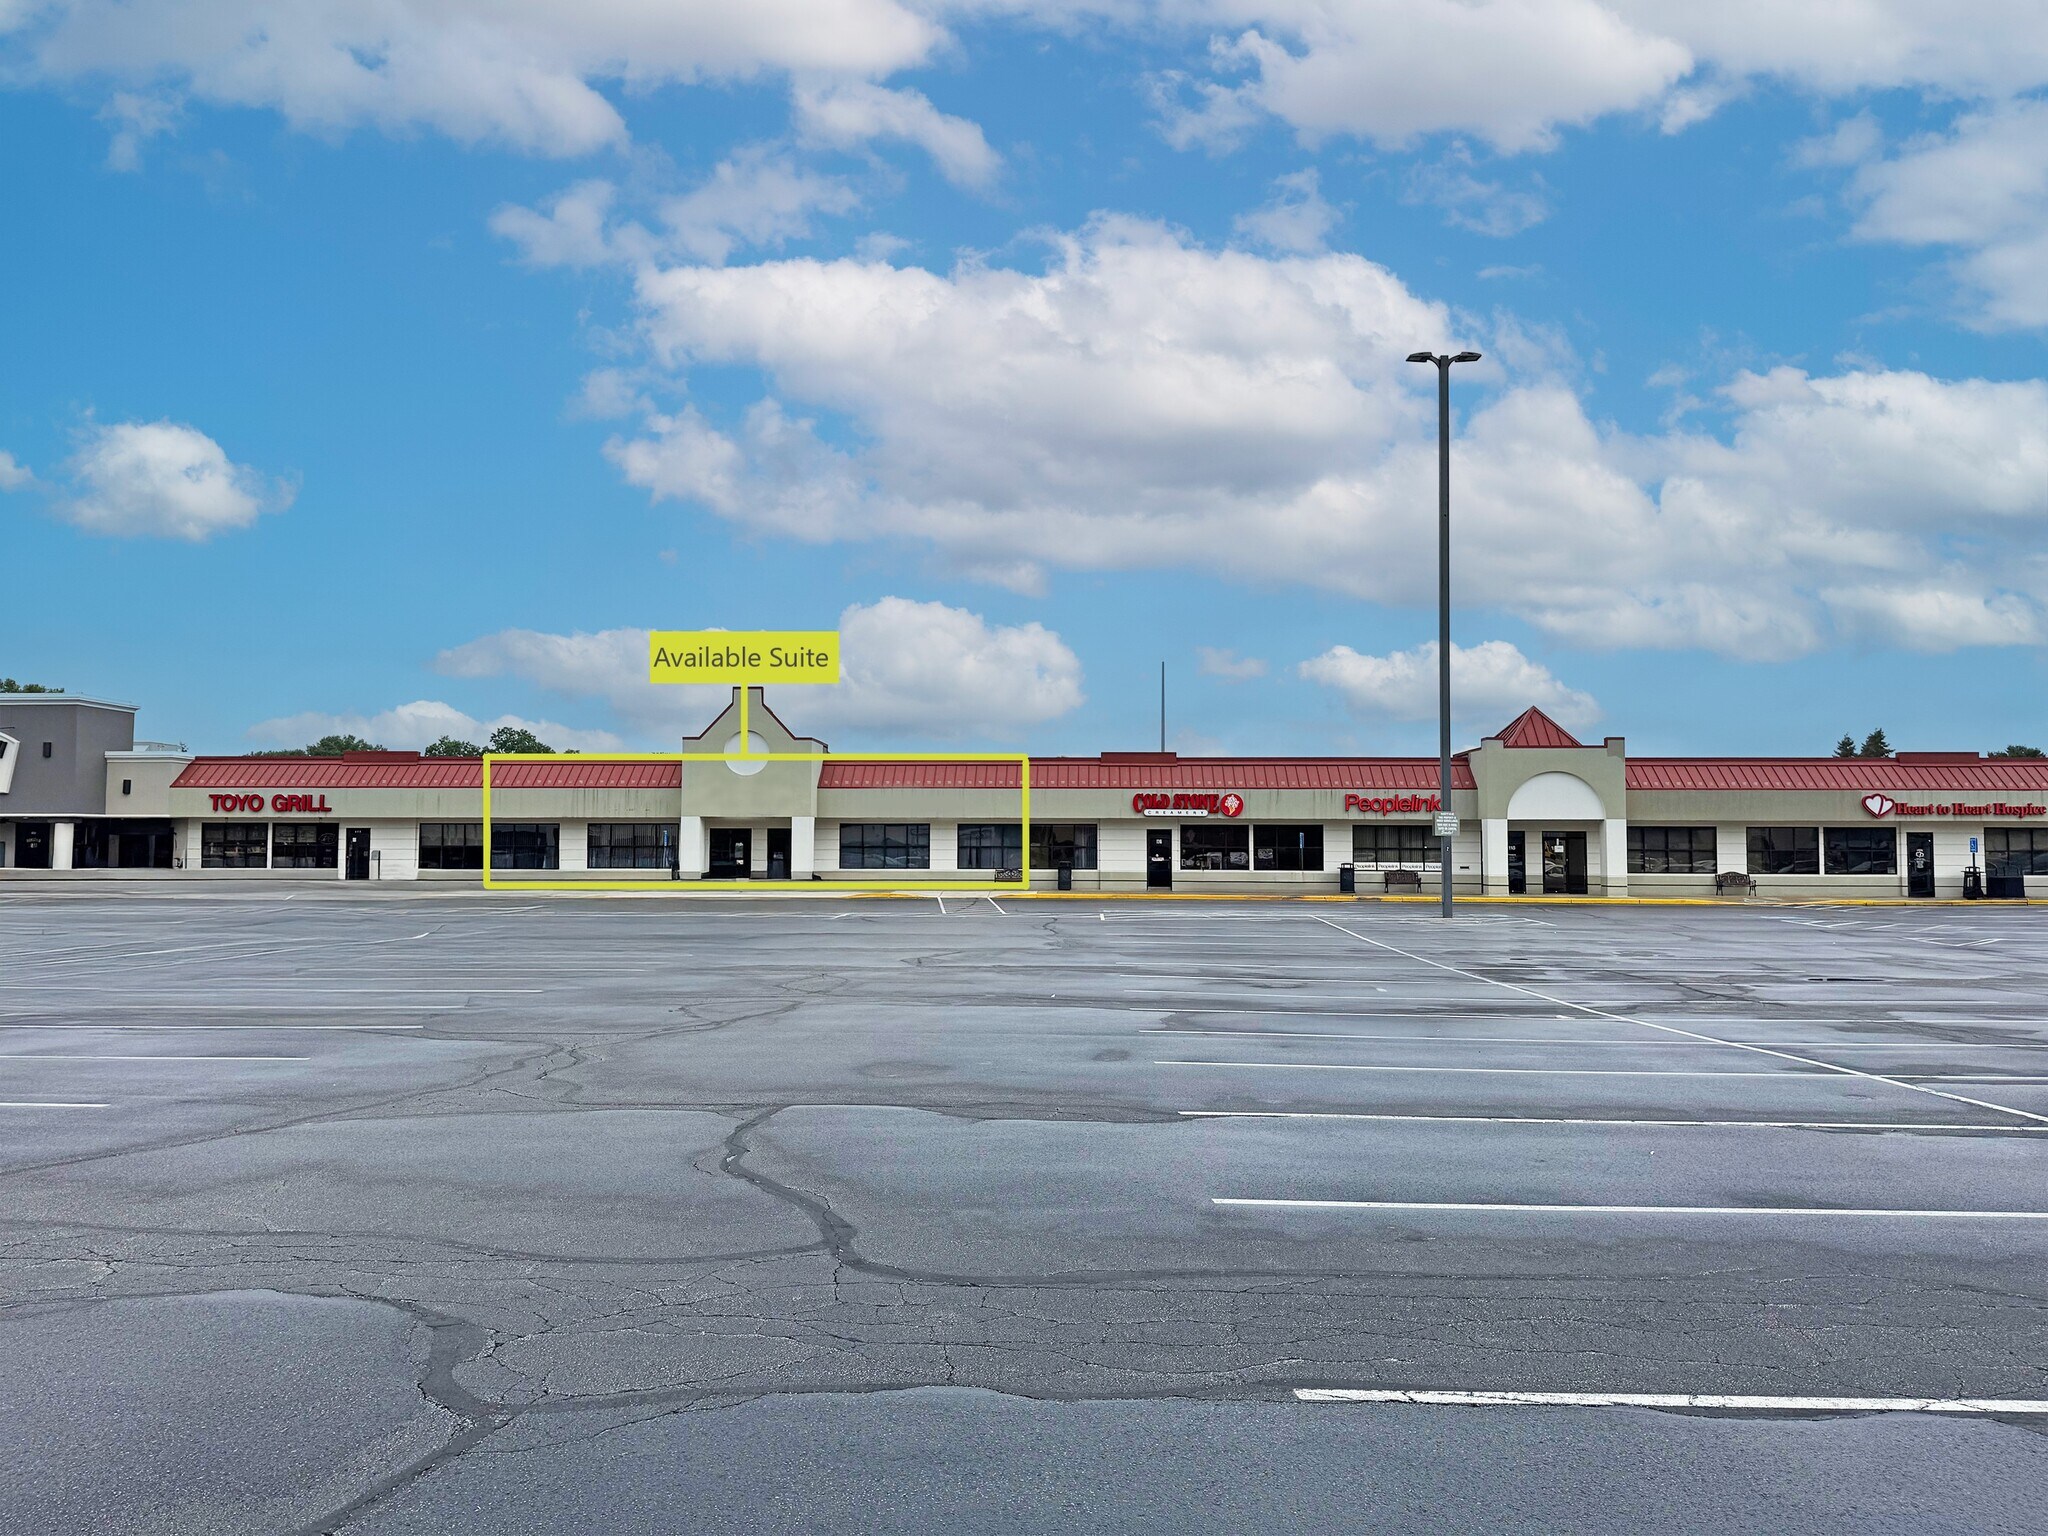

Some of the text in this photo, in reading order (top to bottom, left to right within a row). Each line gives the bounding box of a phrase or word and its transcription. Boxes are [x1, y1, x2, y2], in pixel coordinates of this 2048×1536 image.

[209, 794, 332, 812] TOYO GRILL
[1133, 793, 1219, 813] COLD STONE
[1345, 794, 1441, 816] Peoplelink
[1895, 803, 2047, 818] Heart to Heart Hospice
